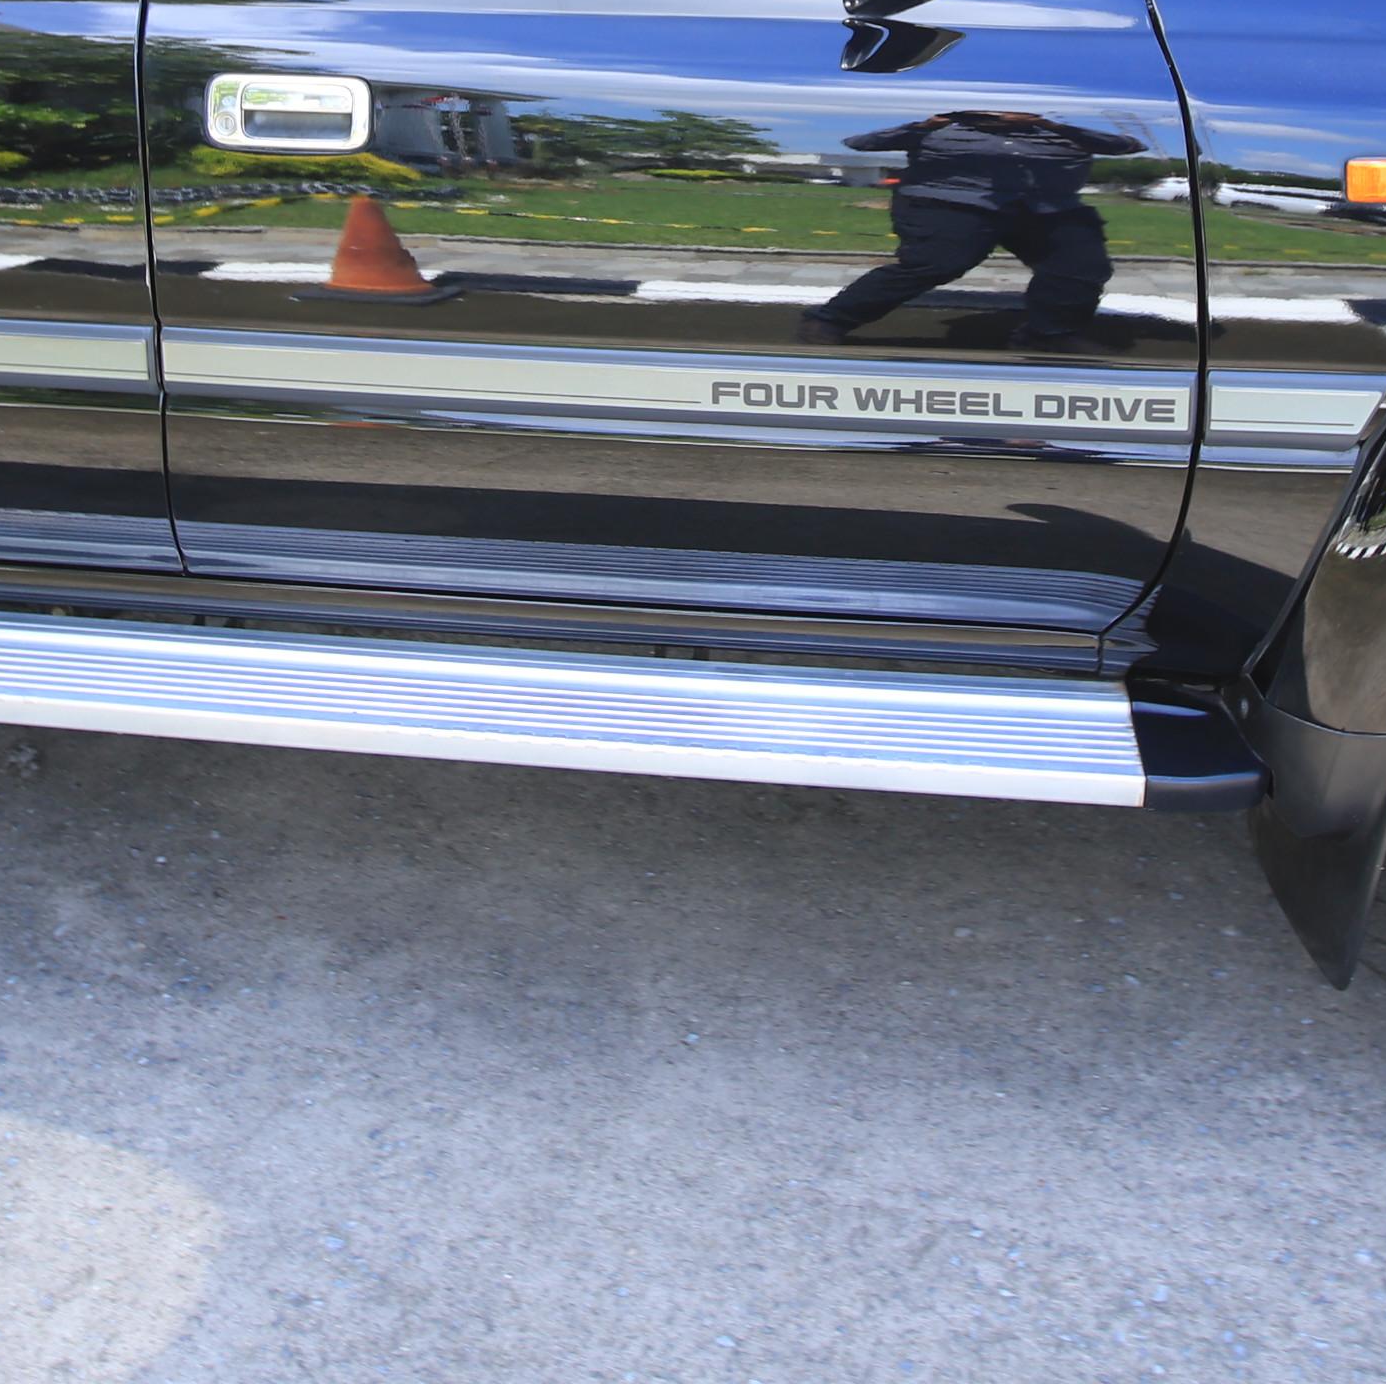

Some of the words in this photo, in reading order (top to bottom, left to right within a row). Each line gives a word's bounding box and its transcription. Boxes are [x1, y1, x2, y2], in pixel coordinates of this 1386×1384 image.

[711, 381, 839, 410] FOUR
[853, 387, 1023, 417] WHEEL
[1034, 394, 1176, 423] DRIVE
